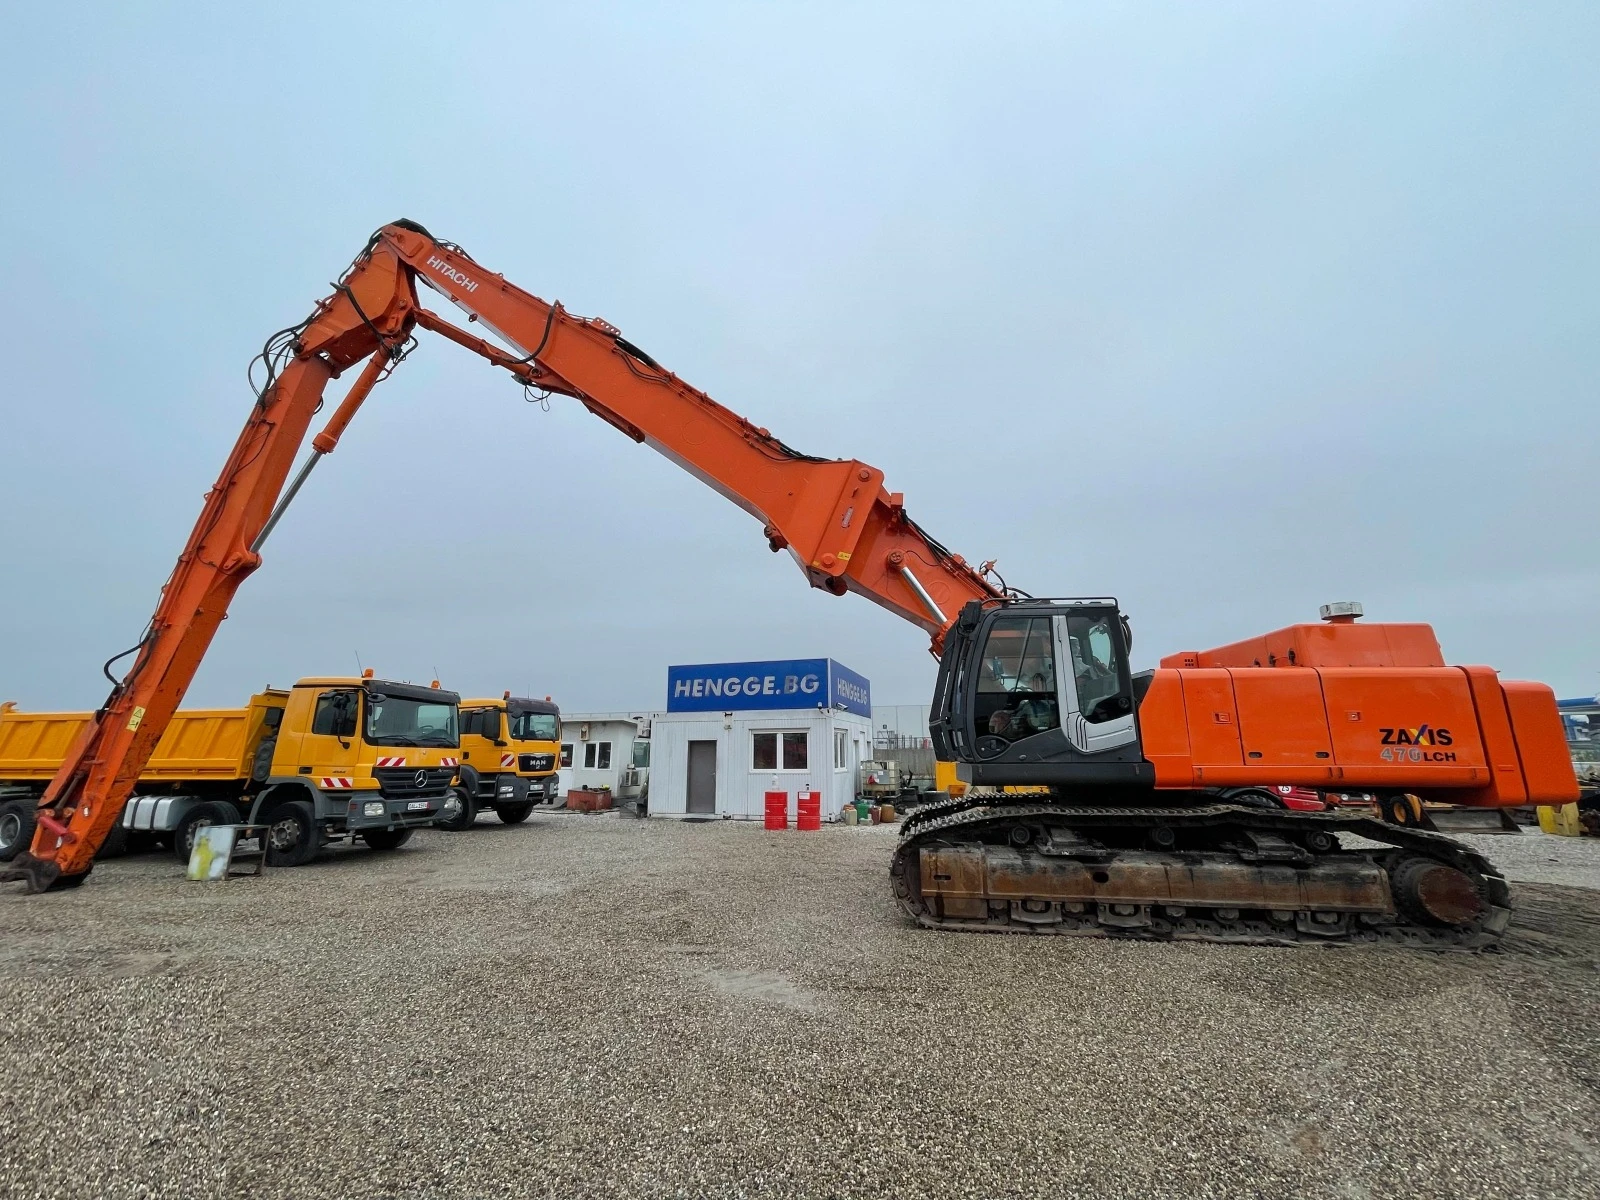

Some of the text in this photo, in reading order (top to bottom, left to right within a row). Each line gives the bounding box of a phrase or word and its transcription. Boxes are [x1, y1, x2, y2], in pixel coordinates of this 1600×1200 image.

[426, 255, 479, 293] HITACHI
[674, 673, 820, 698] HENGGE.BG
[837, 677, 868, 706] HENGGE.BG
[1379, 724, 1453, 746] ZAXIS
